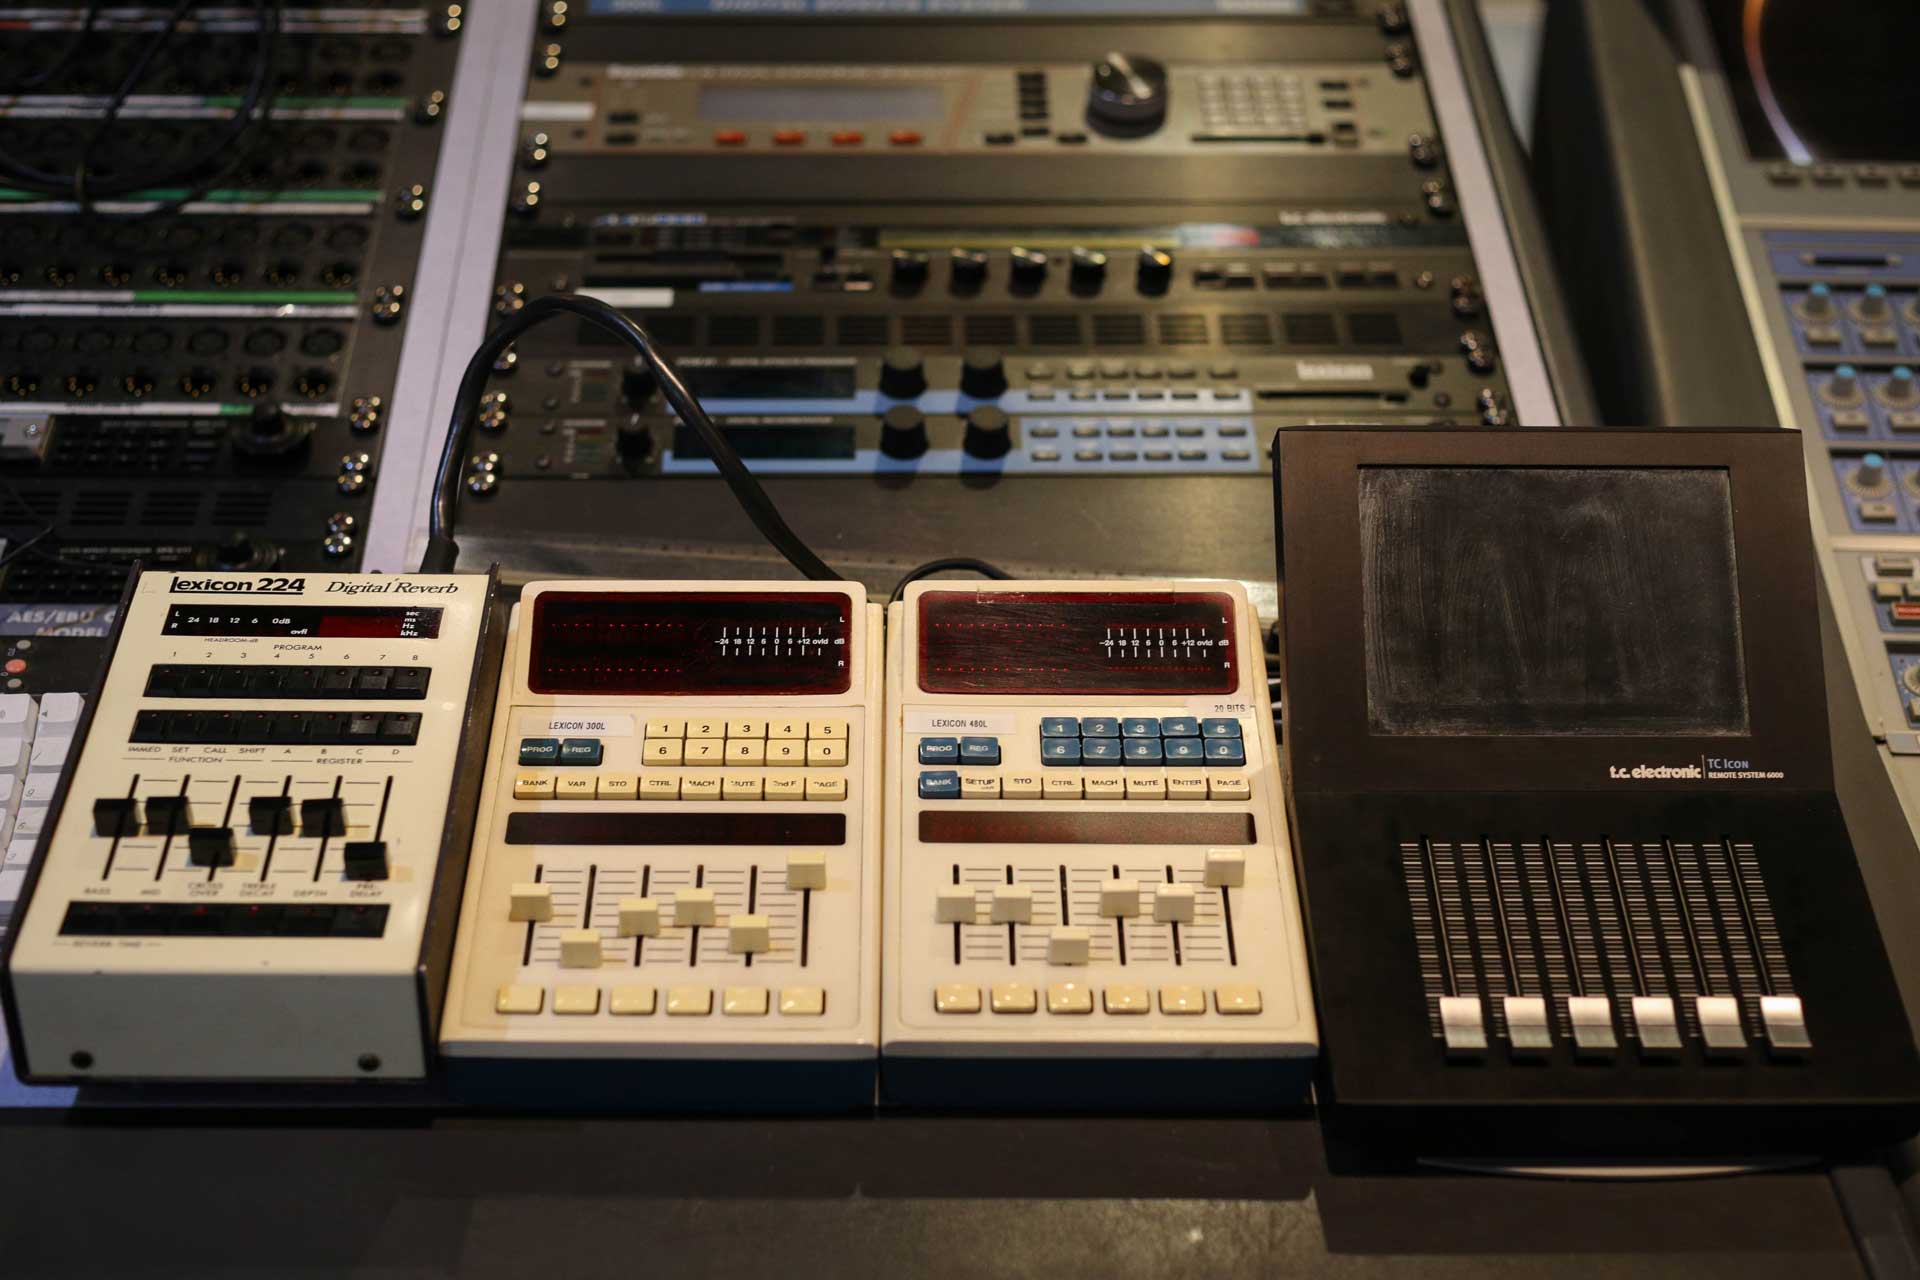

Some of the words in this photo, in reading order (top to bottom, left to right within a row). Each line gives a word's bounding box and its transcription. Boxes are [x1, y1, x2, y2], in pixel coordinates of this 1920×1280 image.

[168, 576, 253, 593] lexicon
[257, 578, 305, 591] 224
[325, 581, 392, 595] Digital
[392, 581, 459, 593] Reverb
[188, 616, 200, 624] 24
[1222, 616, 1228, 624] L
[308, 652, 315, 660] 5
[1214, 704, 1224, 713] 20
[1226, 704, 1246, 713] BITS
[548, 721, 584, 730] LEXICON
[586, 722, 606, 730] 300L
[932, 720, 967, 728] LEXICON
[970, 720, 988, 728] 480L
[662, 724, 669, 733] 1
[702, 725, 710, 733] 2
[743, 724, 751, 733] 3
[784, 725, 792, 733] 4
[824, 726, 832, 735] 5
[1056, 724, 1064, 732] 1
[1096, 724, 1105, 733] 2
[1136, 724, 1145, 733] 3
[1174, 724, 1185, 732] 4
[1216, 725, 1226, 734] 5
[658, 746, 668, 755] 6
[700, 746, 709, 755] 7
[741, 746, 749, 755] 8
[782, 747, 790, 756] 9
[823, 748, 831, 756] 0
[926, 744, 953, 752] PROG
[969, 744, 989, 752] REG
[1056, 746, 1066, 754] 6
[1096, 746, 1106, 754] 7
[1138, 746, 1148, 755] 8
[1178, 746, 1189, 755] 9
[1220, 746, 1228, 755] 0
[168, 756, 222, 764] FUNCTION
[1707, 758, 1722, 769] TC
[1609, 765, 1631, 779] t.c.
[1632, 764, 1702, 779] electronic
[1708, 771, 1737, 779] REMOTE
[965, 778, 995, 786] SETUP
[1172, 778, 1202, 786] ENTER
